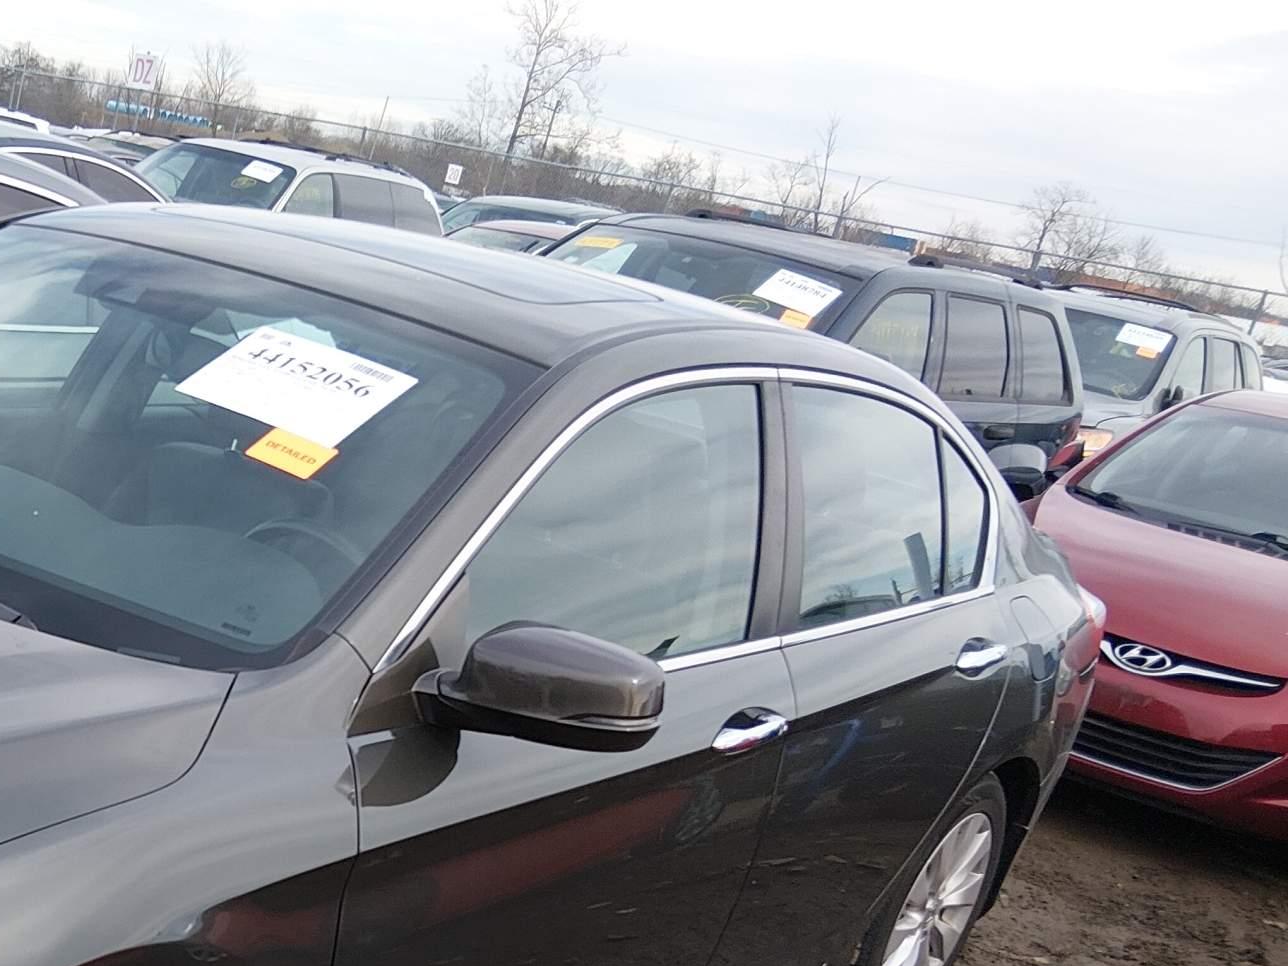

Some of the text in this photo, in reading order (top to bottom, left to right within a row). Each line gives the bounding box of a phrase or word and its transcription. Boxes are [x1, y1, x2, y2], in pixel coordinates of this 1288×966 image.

[132, 57, 154, 84] DZ
[248, 348, 375, 398] 44152056
[264, 438, 318, 466] DETAILED
